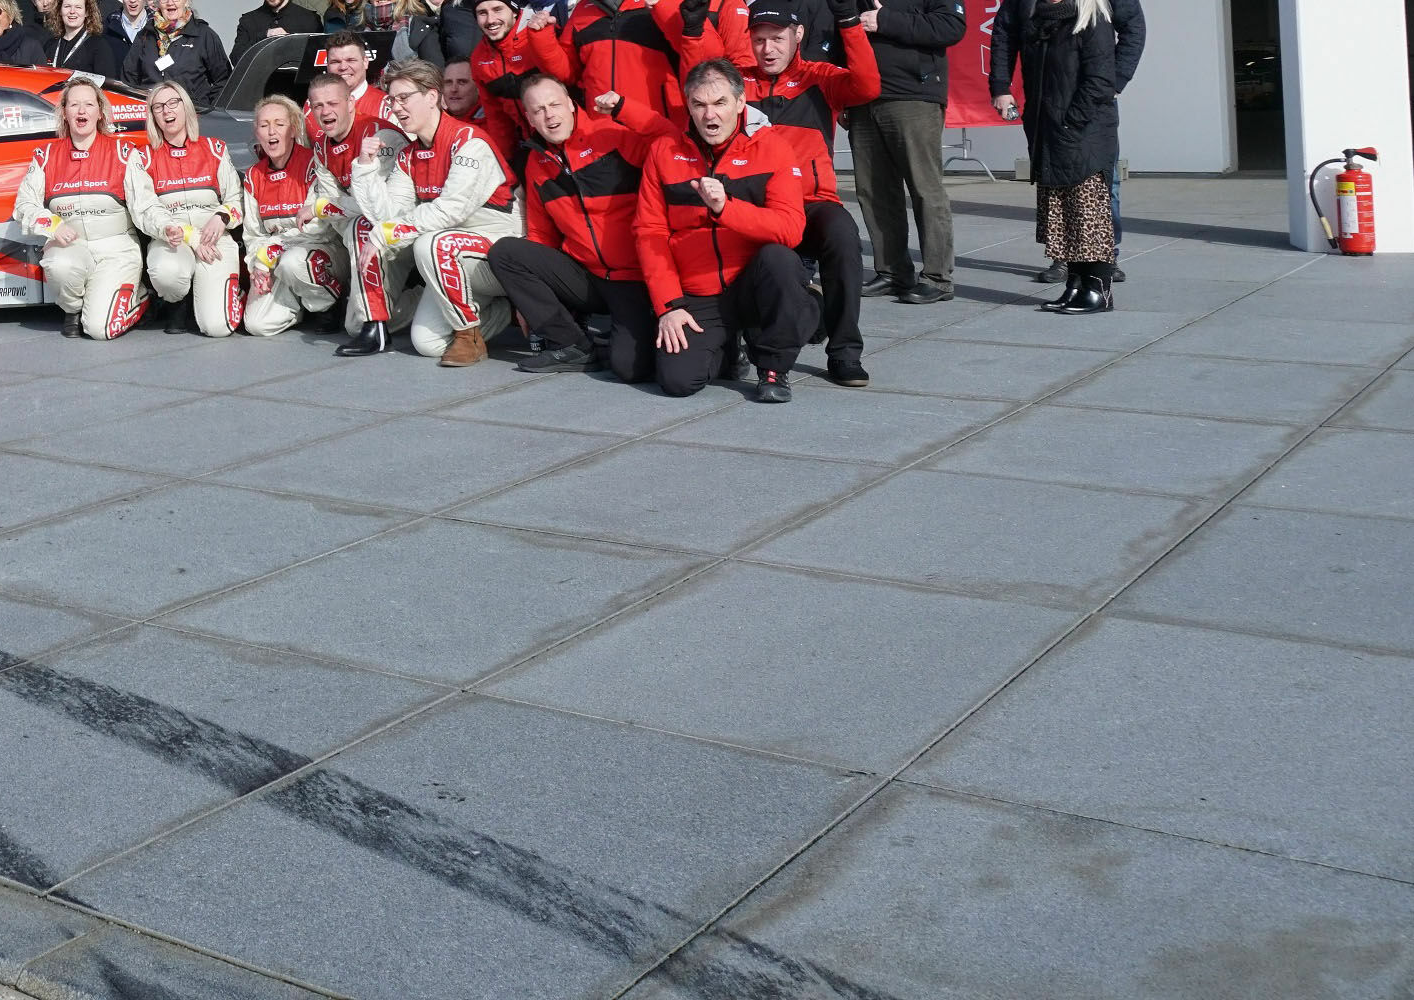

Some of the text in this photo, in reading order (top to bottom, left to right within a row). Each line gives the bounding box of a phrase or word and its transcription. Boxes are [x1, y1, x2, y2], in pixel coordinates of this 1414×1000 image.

[112, 111, 147, 120] WORKWE
[62, 180, 108, 189] Audi Sport
[166, 175, 212, 186] Audi Sport
[56, 203, 75, 212] Audi
[180, 203, 212, 212] Service
[266, 202, 304, 212] Audi Sport
[74, 208, 106, 216] Service
